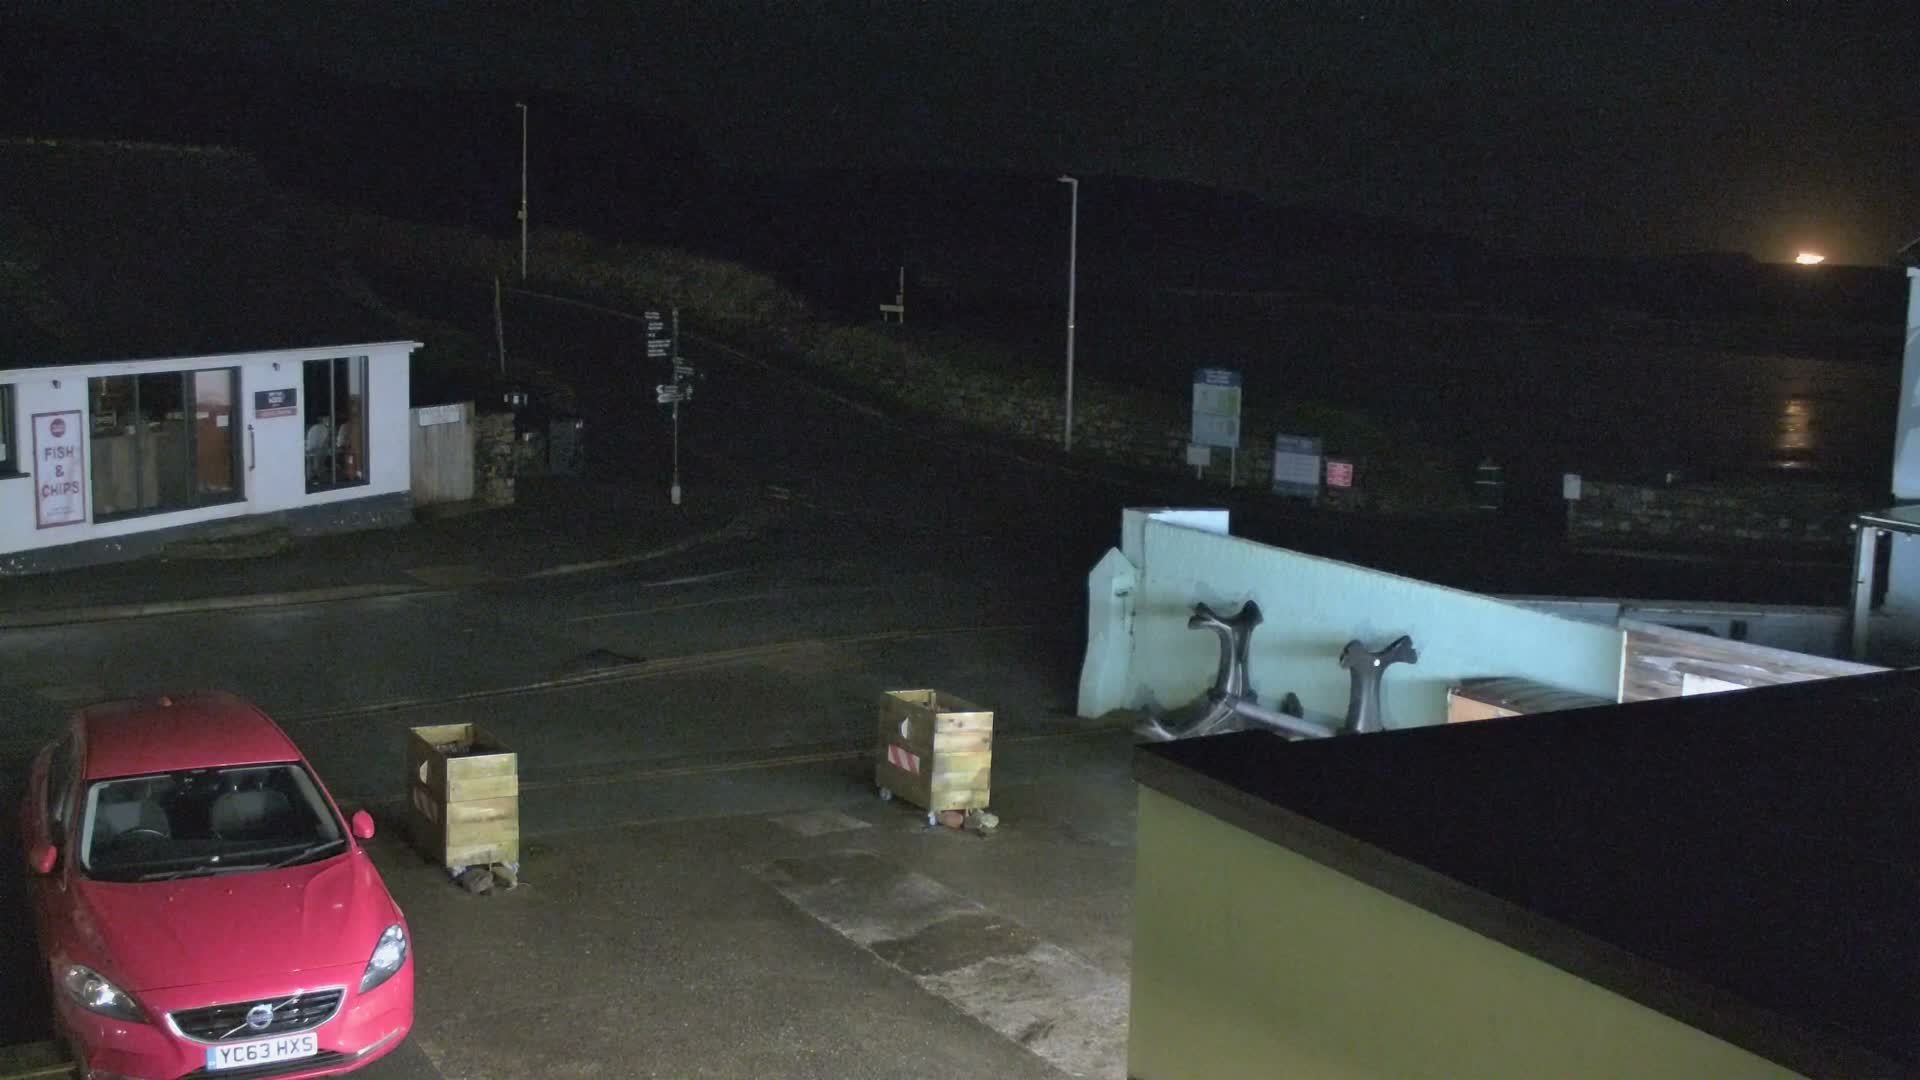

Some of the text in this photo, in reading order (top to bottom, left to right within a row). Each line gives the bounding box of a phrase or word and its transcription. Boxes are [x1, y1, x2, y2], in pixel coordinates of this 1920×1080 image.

[44, 446, 74, 461] FISH
[55, 464, 65, 478] &
[41, 481, 79, 498] CHIPS
[220, 1037, 313, 1063] YC63 HXS
